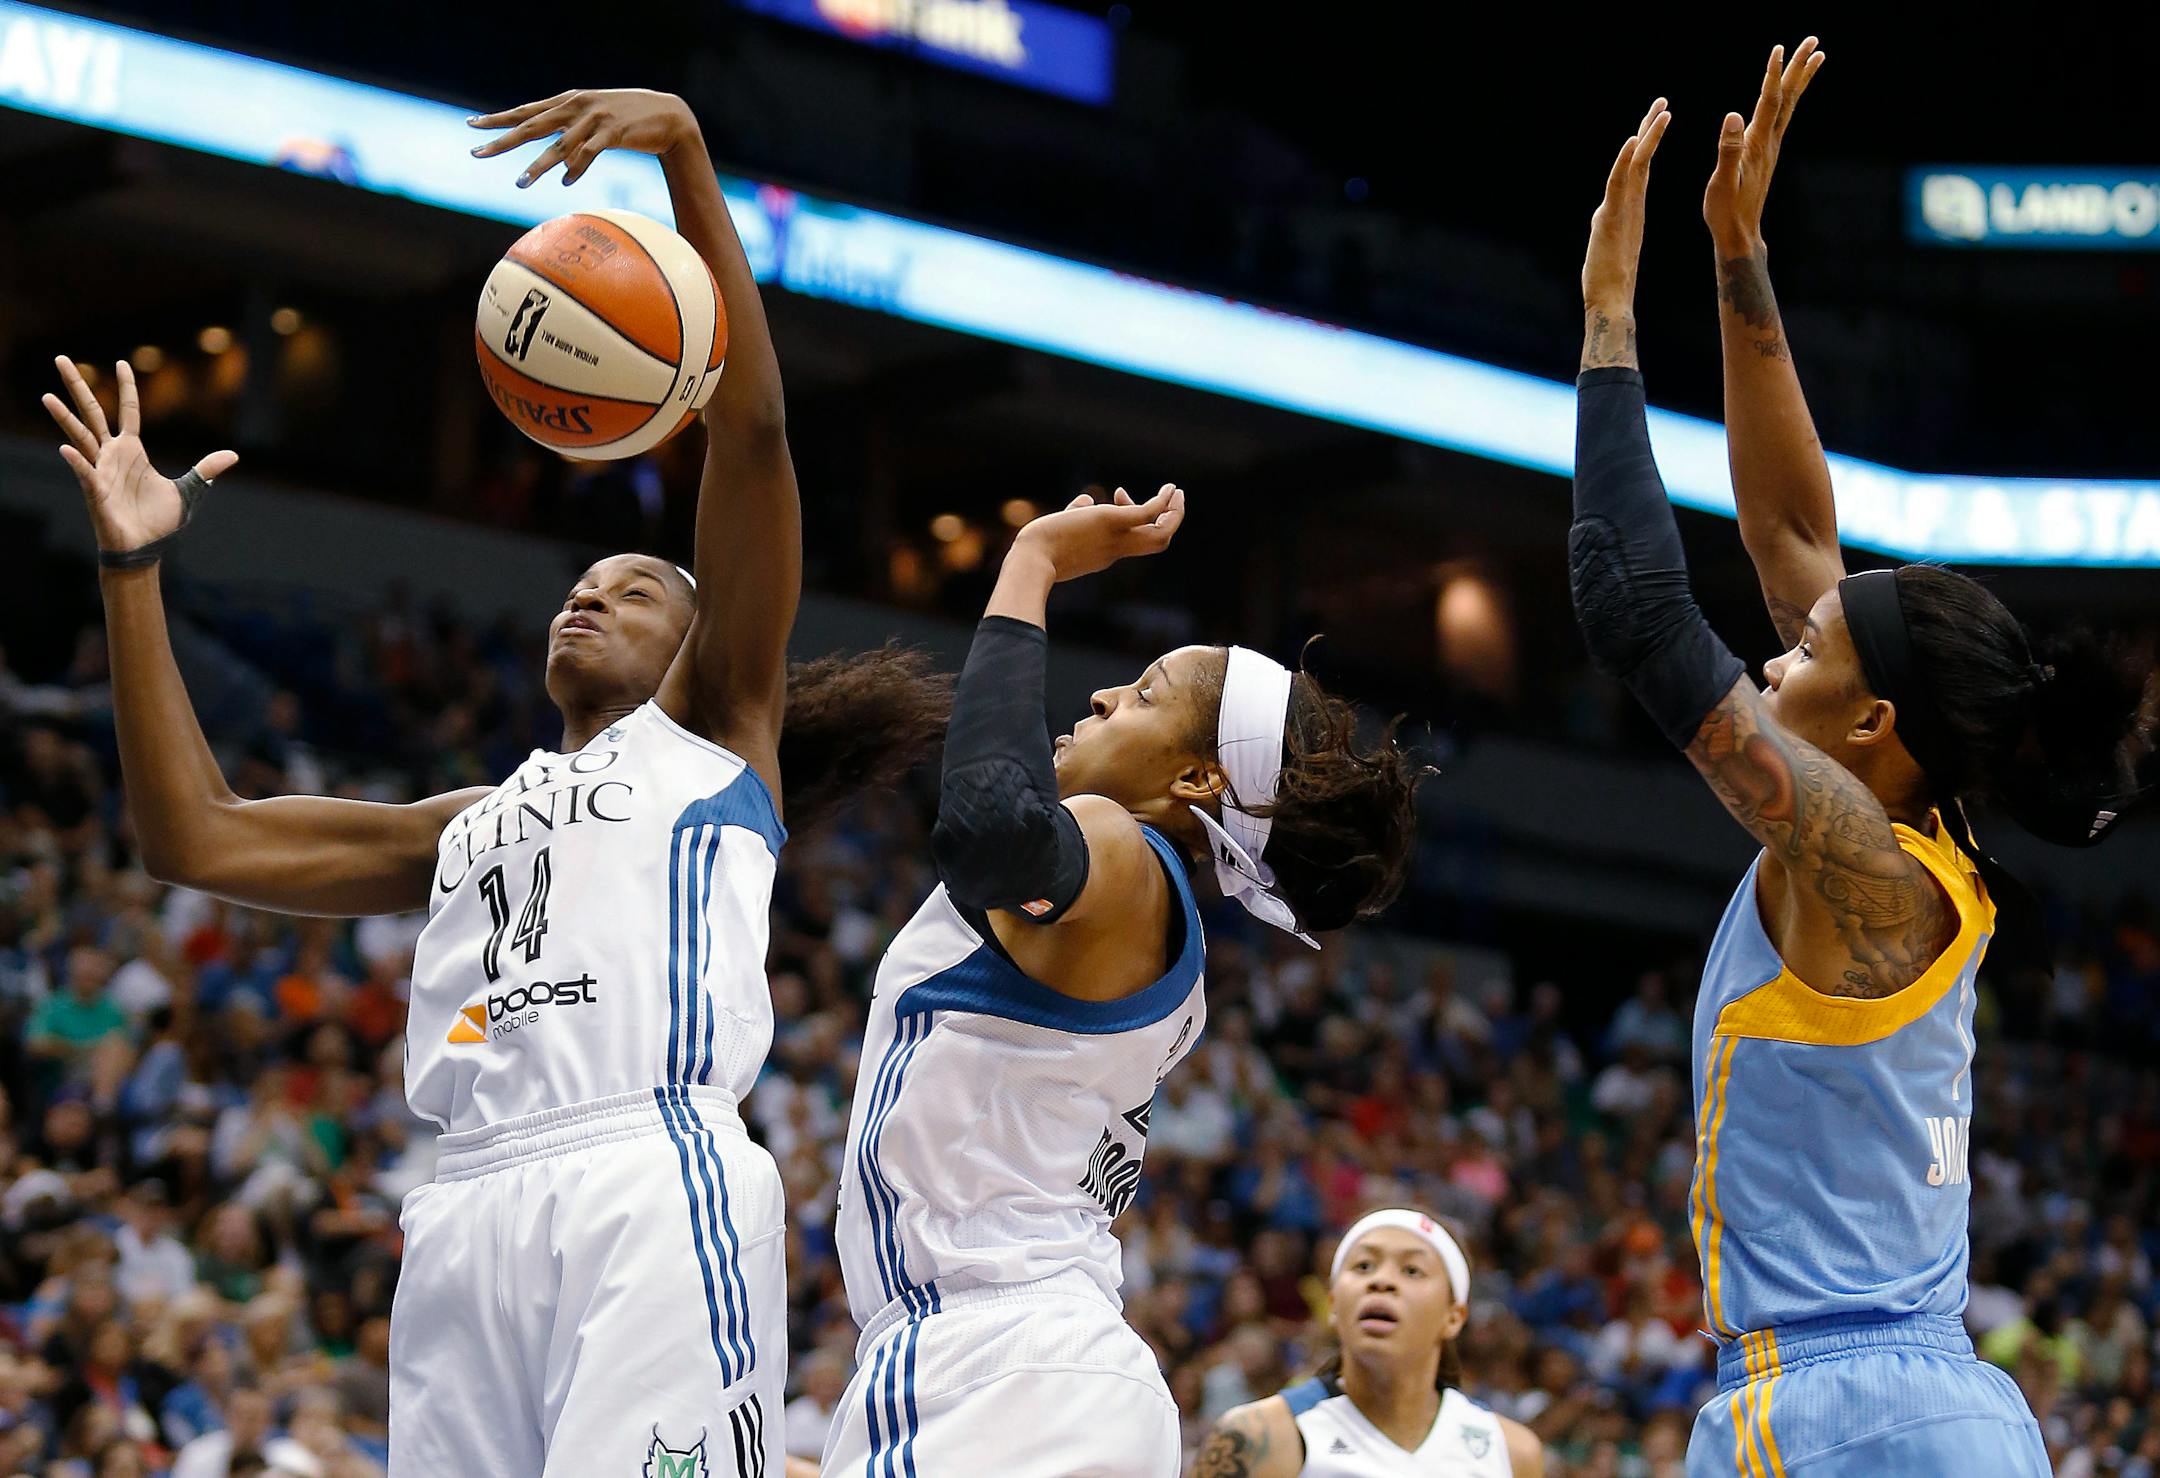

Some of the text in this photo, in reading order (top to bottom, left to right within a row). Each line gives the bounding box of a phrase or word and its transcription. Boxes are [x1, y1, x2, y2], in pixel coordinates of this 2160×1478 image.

[440, 781, 633, 893] CLINIC
[477, 845, 551, 984] 14
[488, 973, 598, 1023] boost
[492, 1010, 540, 1041] mobile
